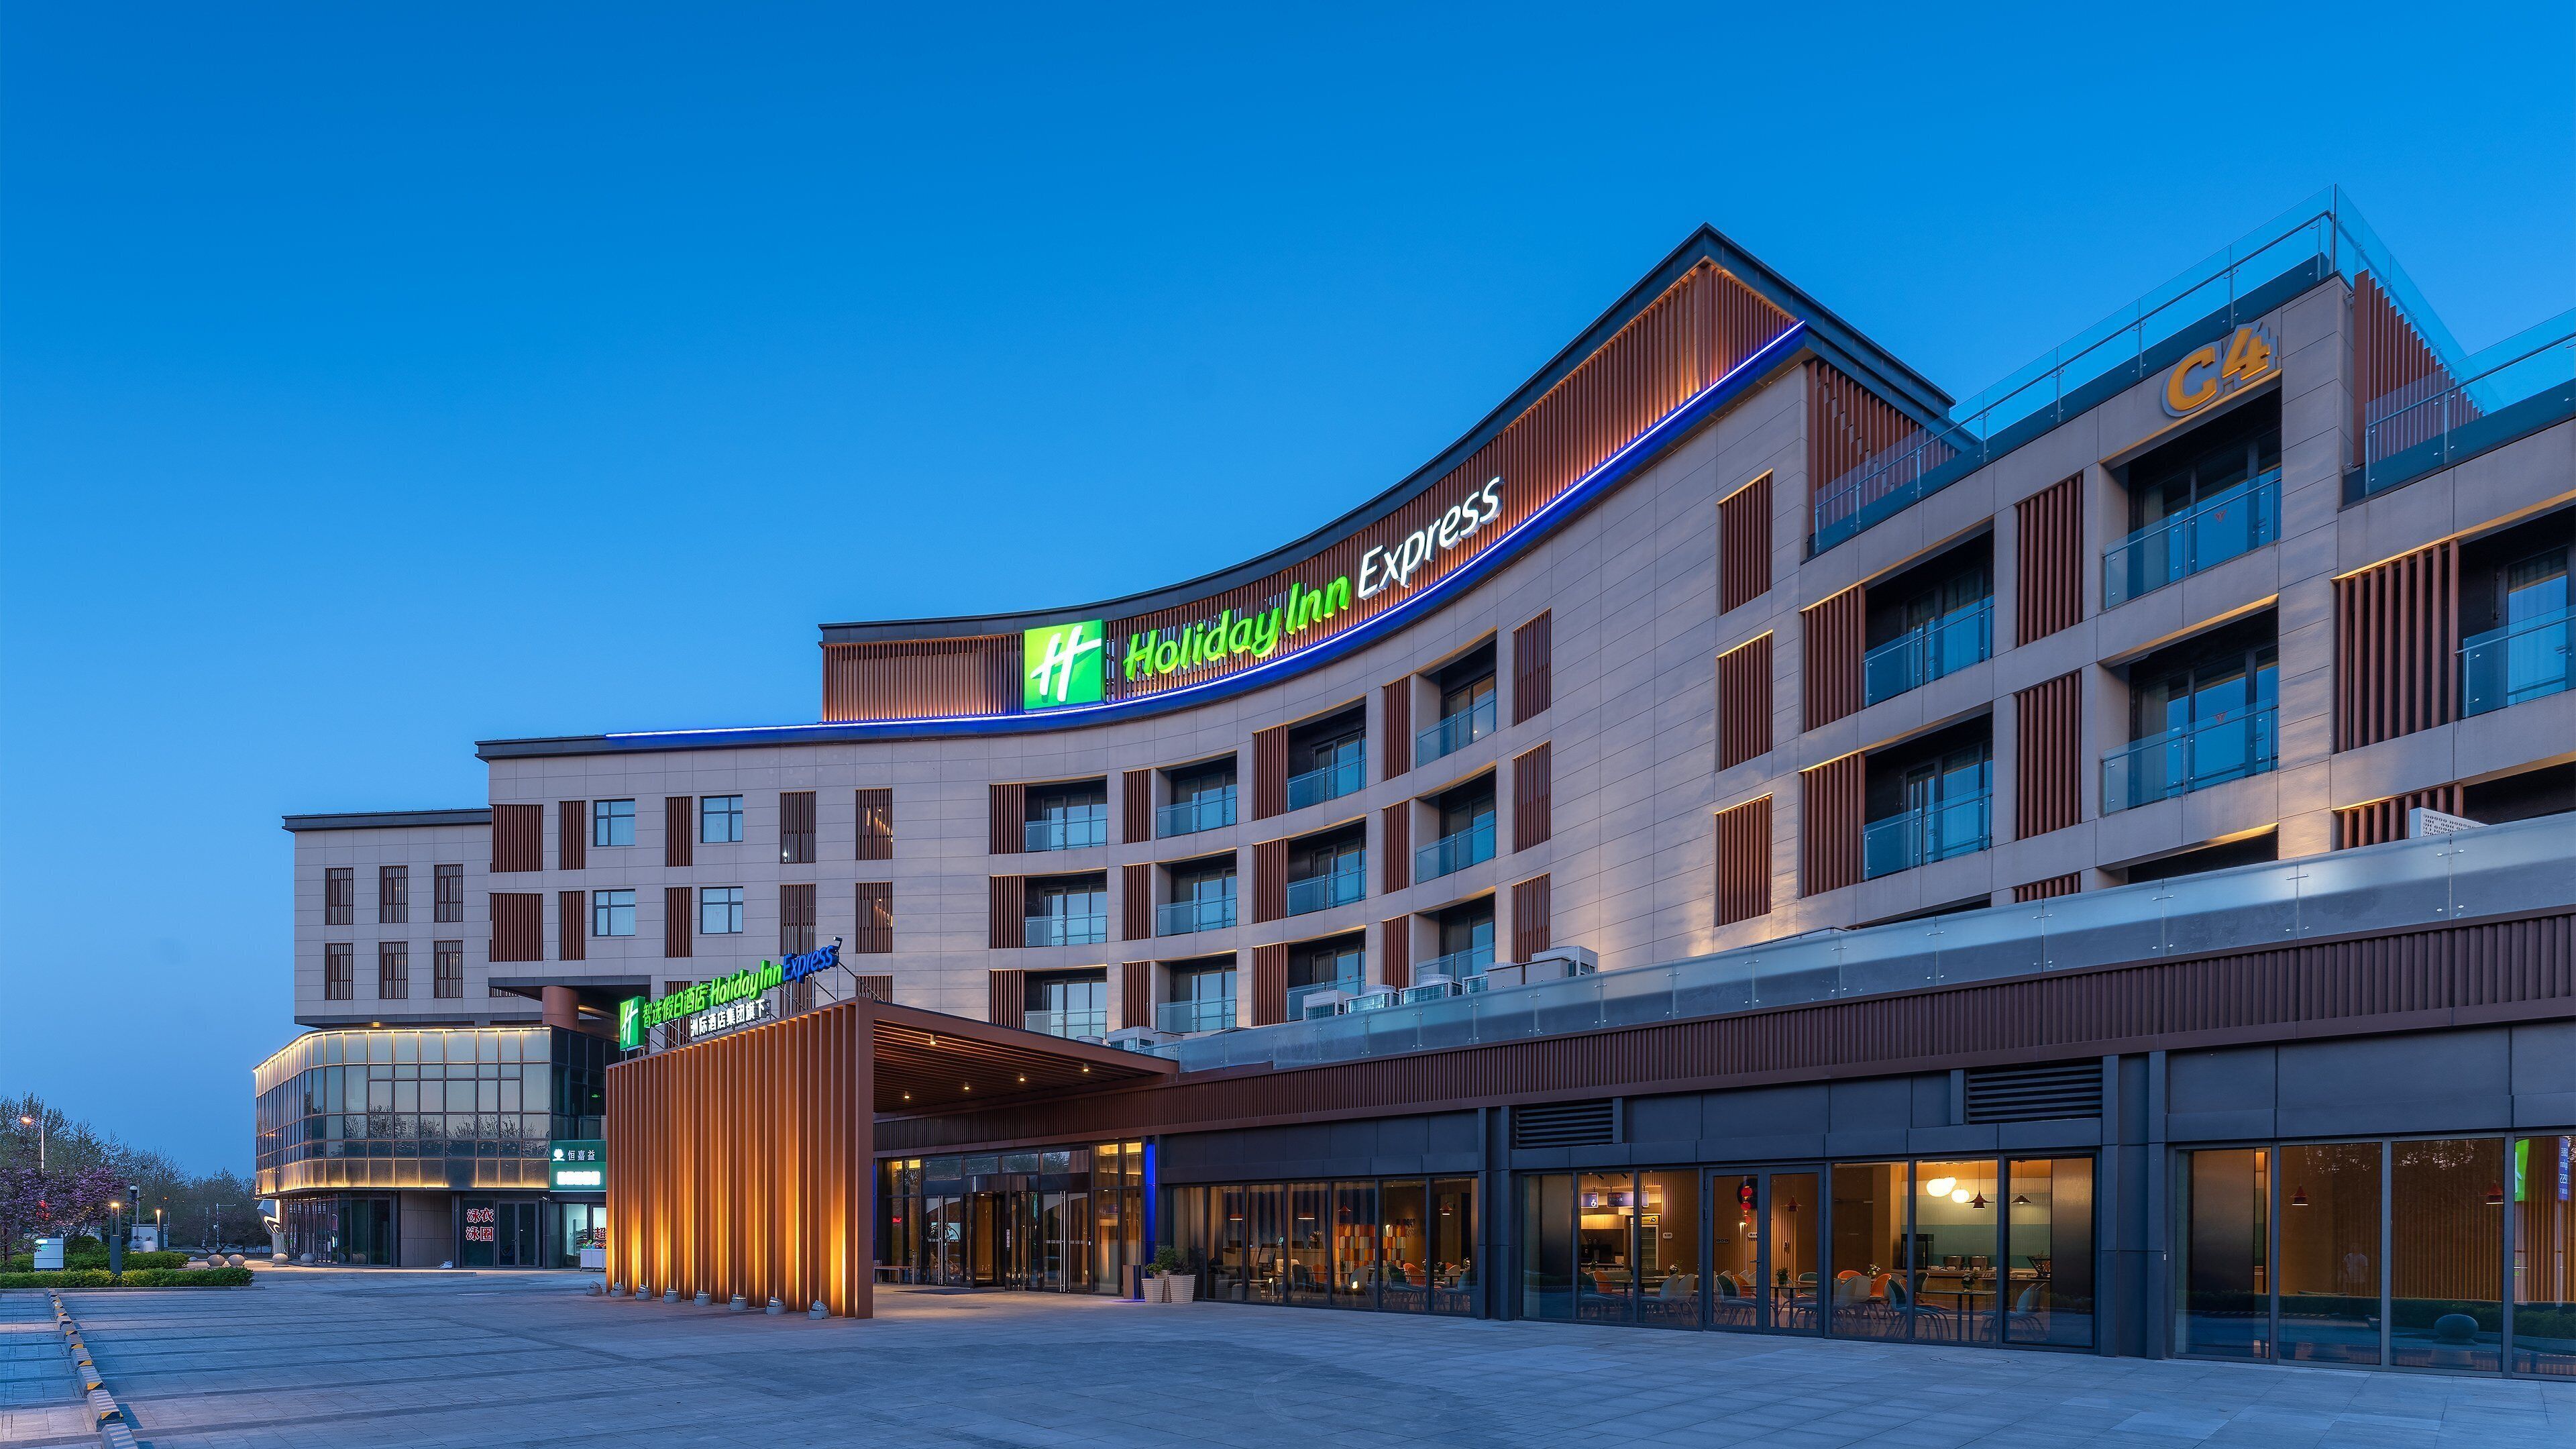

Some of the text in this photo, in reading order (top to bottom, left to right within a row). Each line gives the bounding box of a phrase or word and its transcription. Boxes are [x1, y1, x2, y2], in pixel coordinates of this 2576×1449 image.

[2165, 325, 2272, 413] C4
[1357, 476, 1505, 600] Express
[643, 983, 708, 1028] 智选假日酒店
[782, 945, 837, 984] Express
[690, 998, 765, 1038] 洲际酒店集团旗下
[568, 1149, 596, 1161] 恒嘉益
[466, 1208, 494, 1224] 泳衣
[466, 1226, 494, 1242] 泳圈
[593, 1227, 606, 1239] 超
